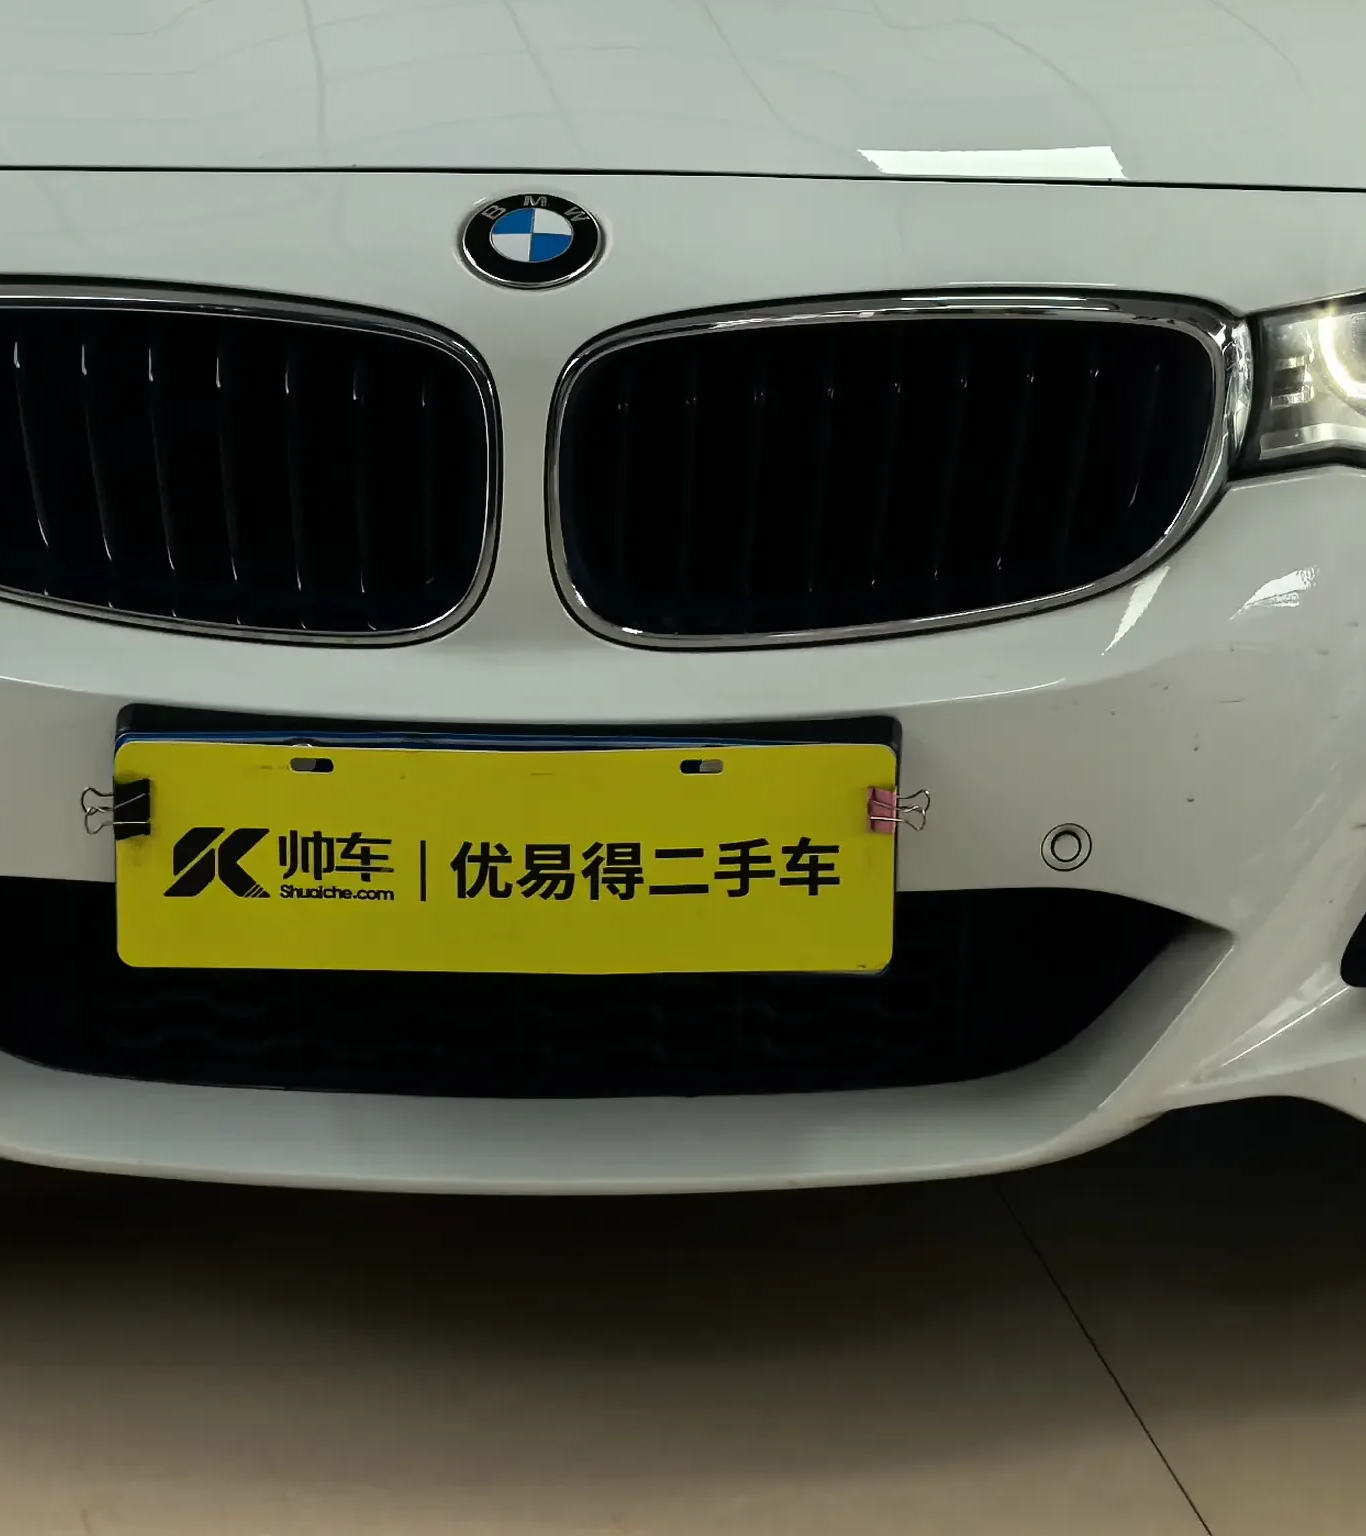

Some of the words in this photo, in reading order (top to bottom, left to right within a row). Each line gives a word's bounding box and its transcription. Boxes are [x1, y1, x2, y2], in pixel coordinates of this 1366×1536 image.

[481, 195, 591, 223] BMW
[278, 829, 395, 883] 帅车
[450, 836, 841, 902] 优易得二手车
[279, 884, 395, 901] Shuaiche.com
